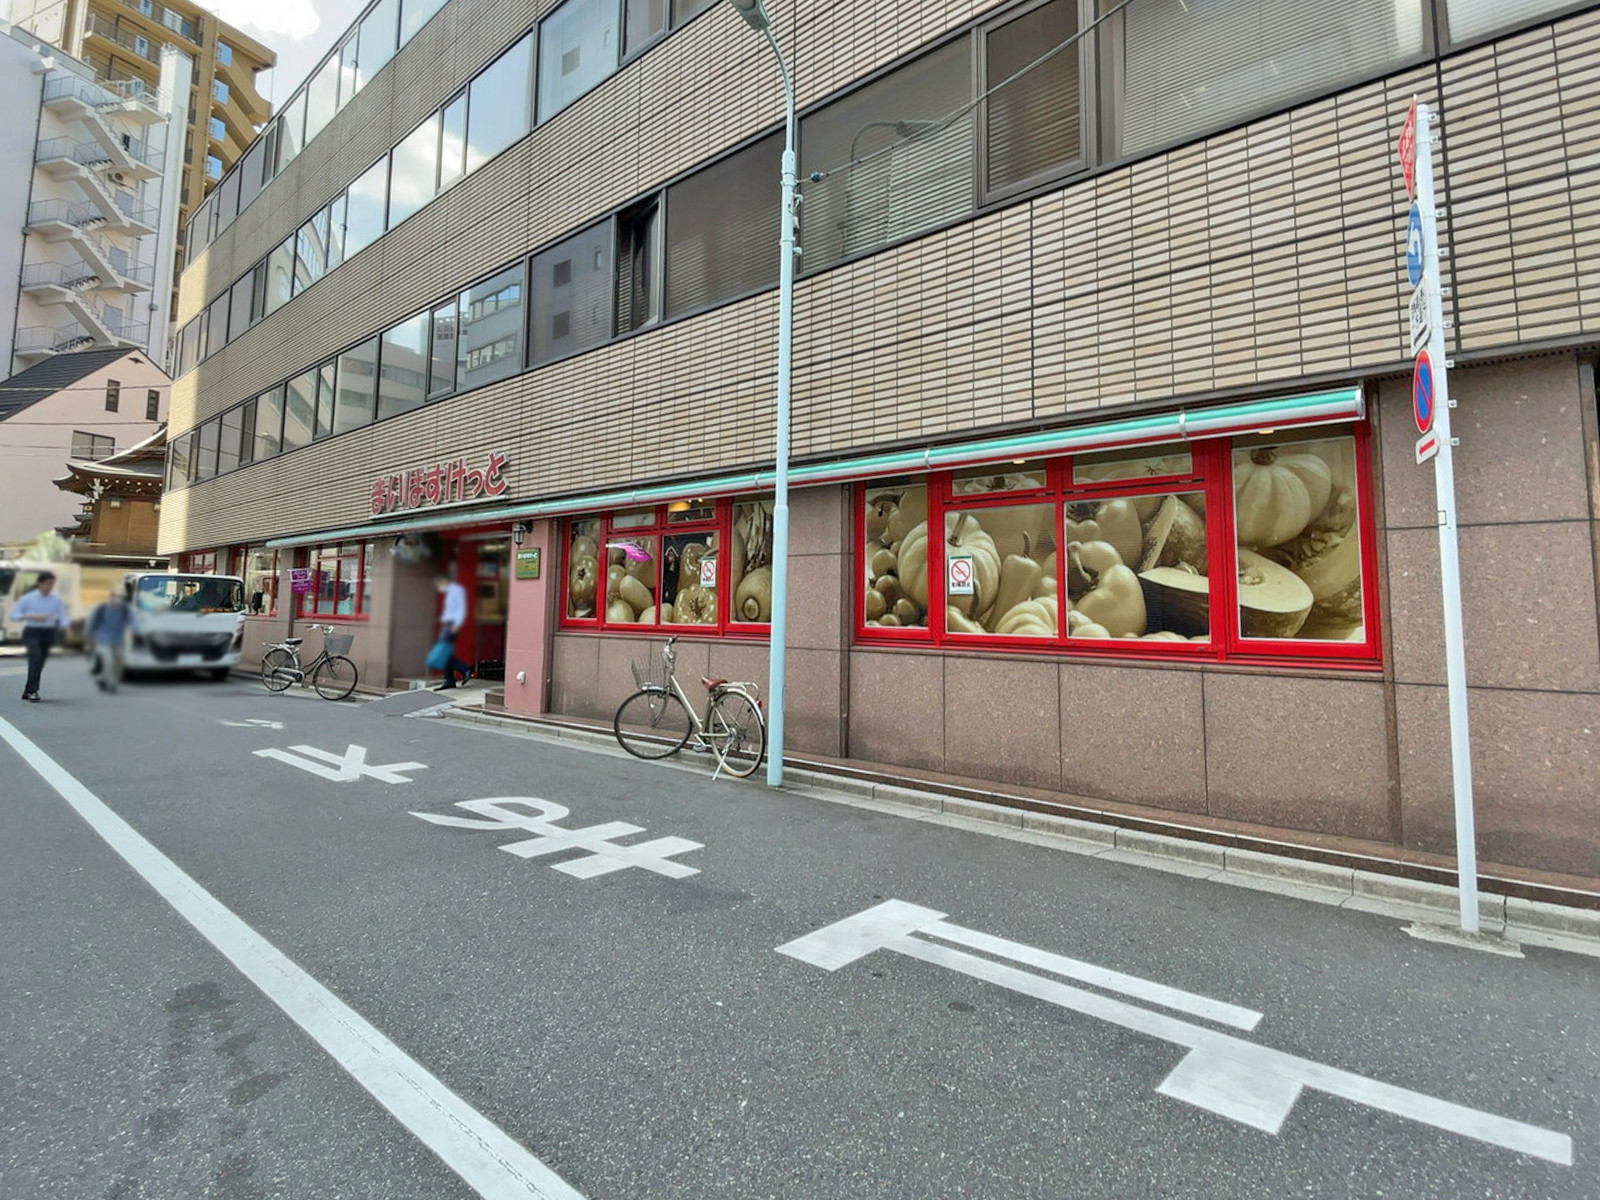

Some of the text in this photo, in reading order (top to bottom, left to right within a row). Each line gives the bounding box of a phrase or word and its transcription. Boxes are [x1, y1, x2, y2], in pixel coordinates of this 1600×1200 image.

[370, 452, 508, 515] まいばすけっと
